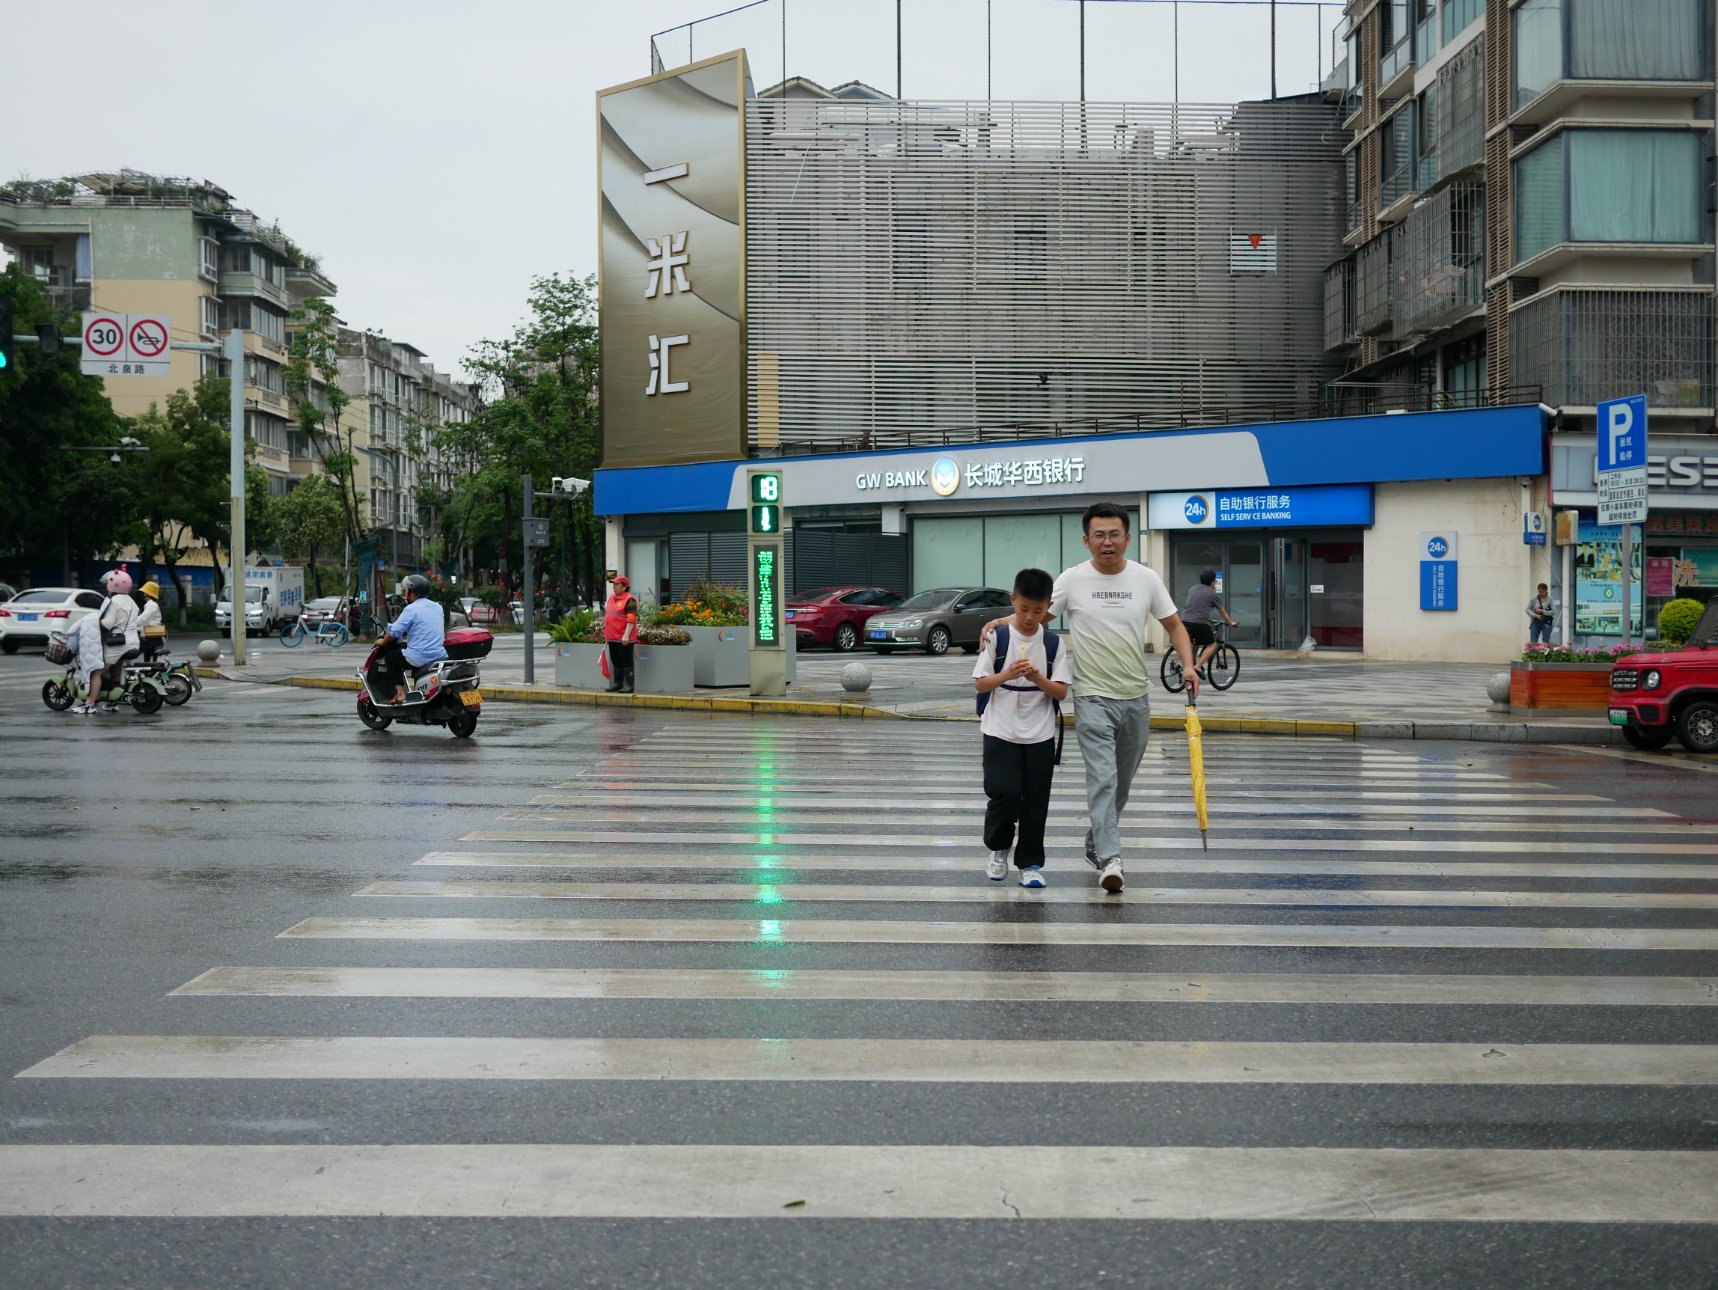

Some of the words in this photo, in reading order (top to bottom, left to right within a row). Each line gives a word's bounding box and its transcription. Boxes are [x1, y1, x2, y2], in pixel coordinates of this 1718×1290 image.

[643, 161, 691, 396] 一米汇
[92, 328, 117, 345] 30
[108, 363, 145, 375] 北泉路
[1608, 403, 1633, 466] P
[855, 473, 880, 490] GW
[885, 469, 928, 488] BANK
[964, 457, 1085, 488] 长城华西银行
[1185, 502, 1206, 516] 24h
[1220, 494, 1291, 511] 自助银行服务
[1220, 513, 1235, 521] SELF
[1235, 512, 1261, 521] SERVCE
[1262, 511, 1291, 520] BANKING
[1429, 542, 1447, 552] 24h
